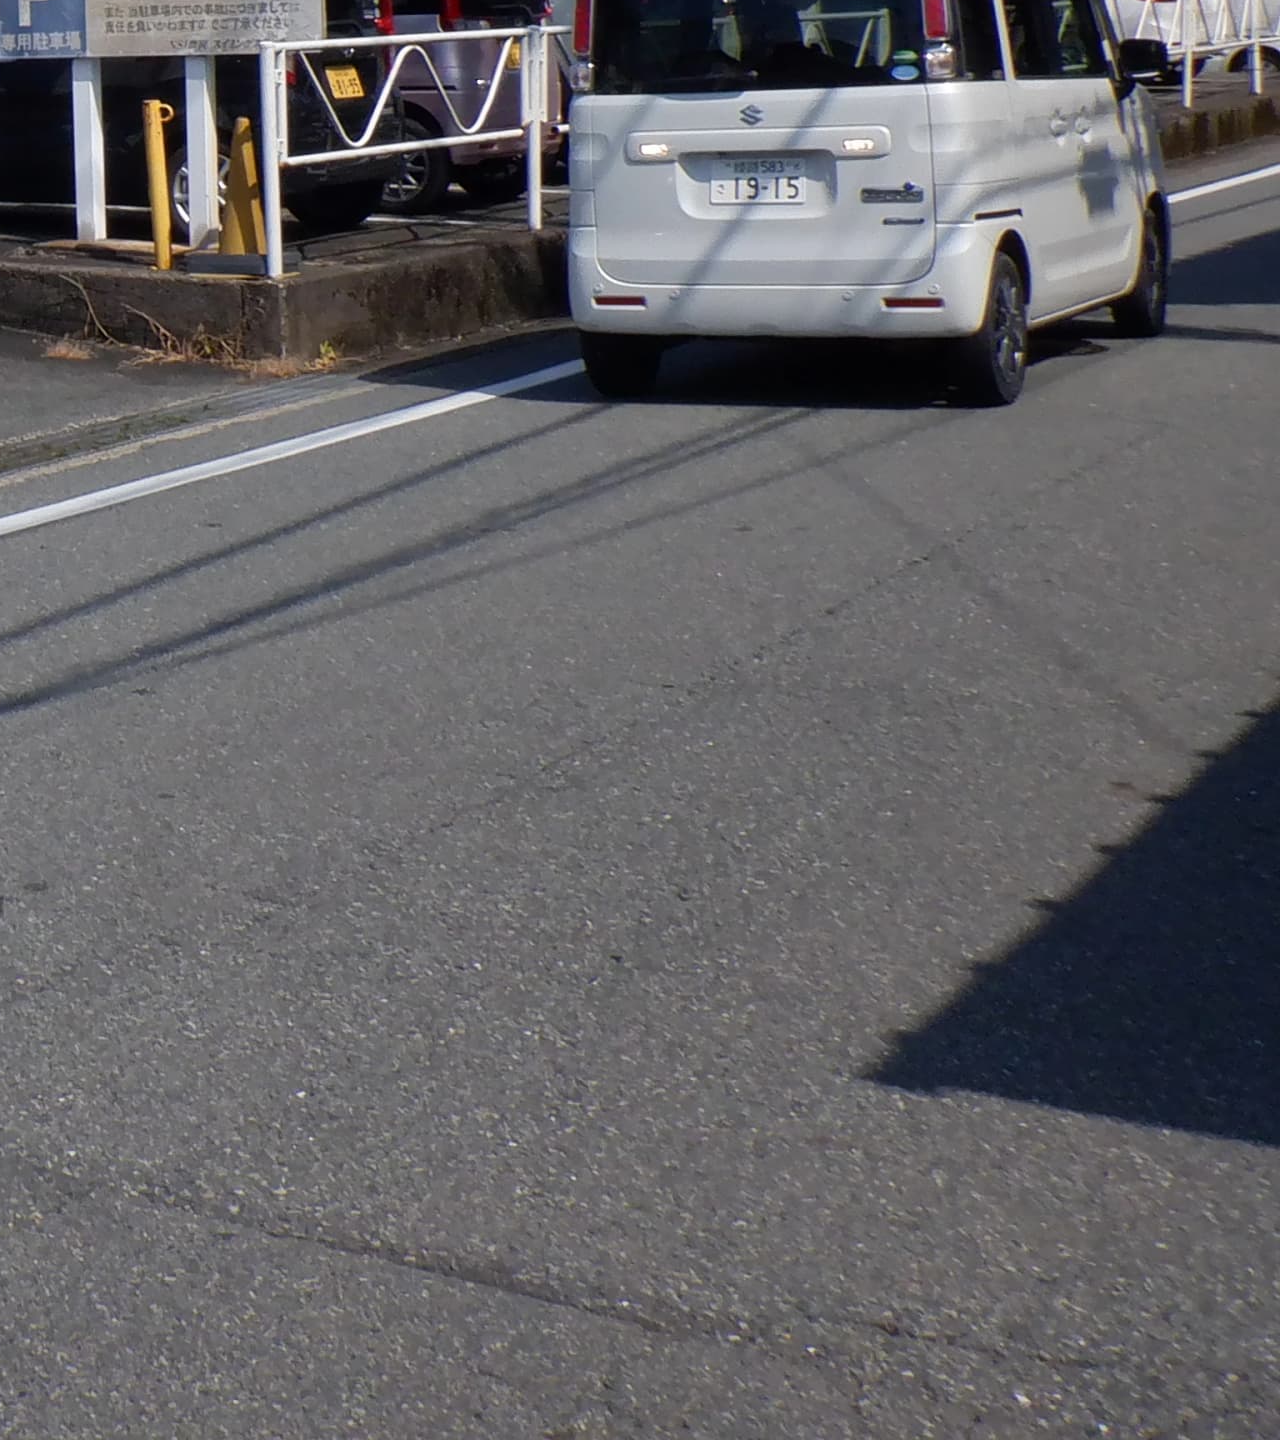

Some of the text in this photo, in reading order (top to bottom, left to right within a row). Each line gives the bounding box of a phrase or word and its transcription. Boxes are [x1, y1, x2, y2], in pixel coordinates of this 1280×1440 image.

[0, 31, 81, 51] 専用駐車場
[734, 176, 800, 200] 19-15
